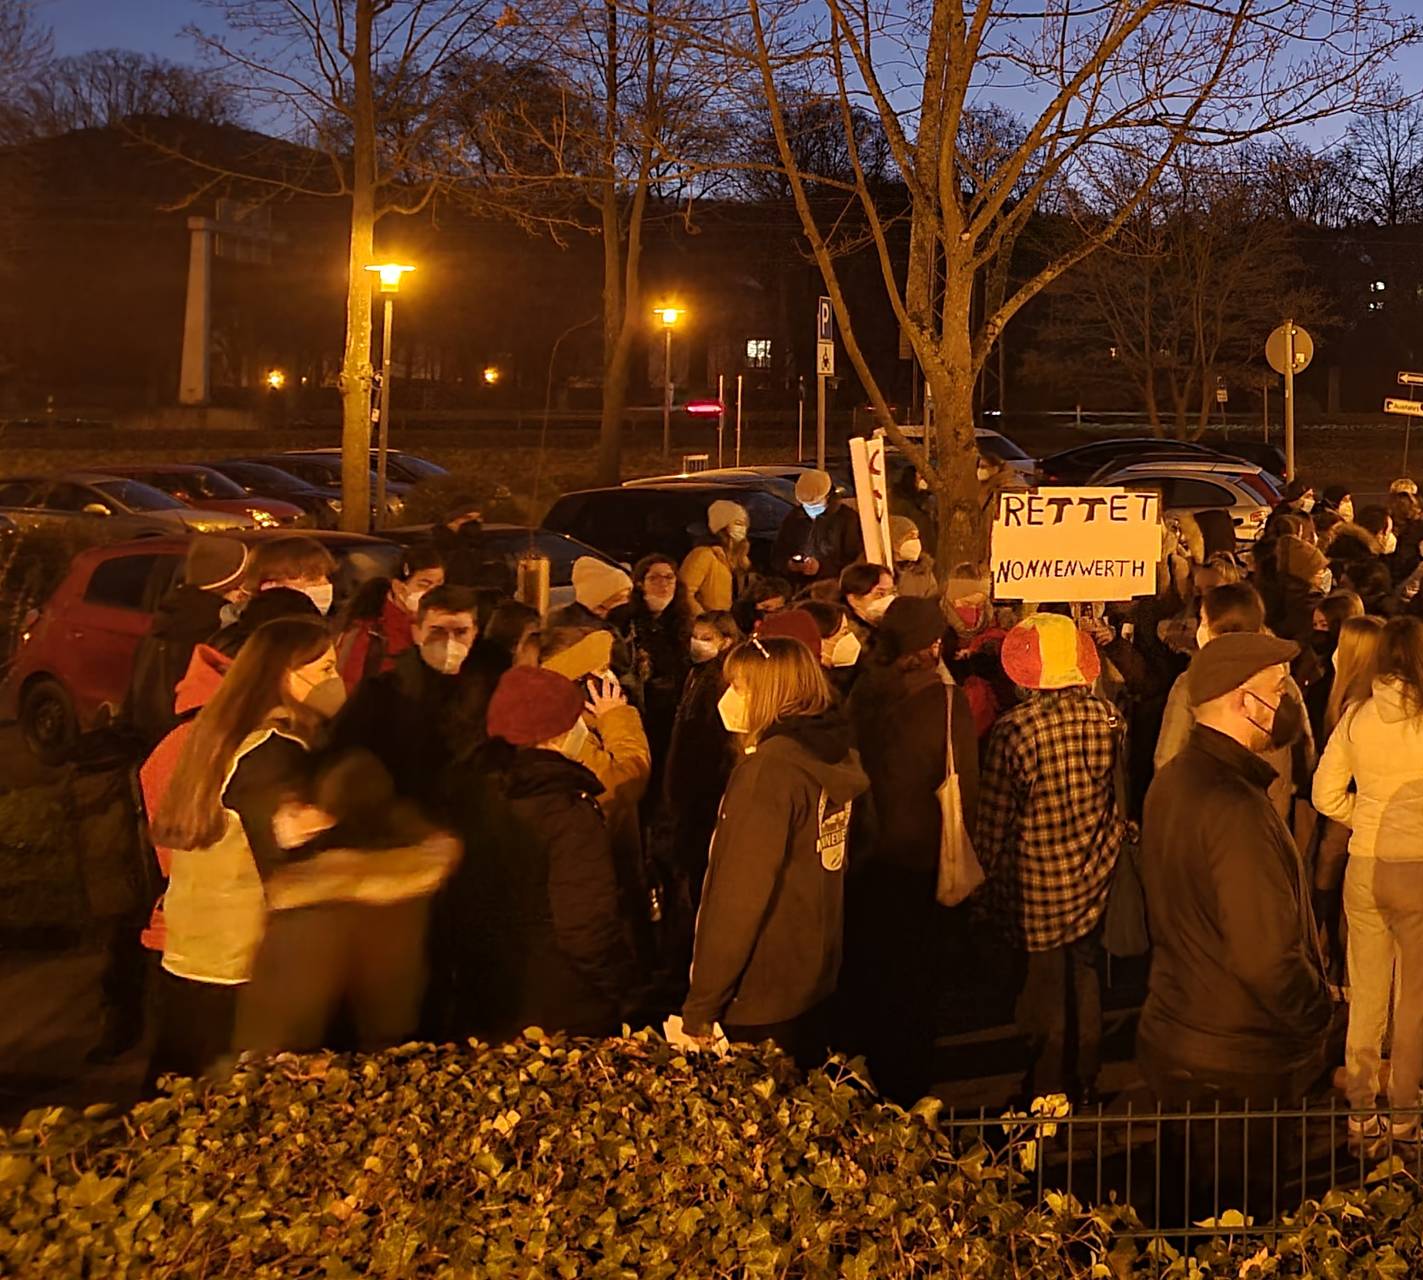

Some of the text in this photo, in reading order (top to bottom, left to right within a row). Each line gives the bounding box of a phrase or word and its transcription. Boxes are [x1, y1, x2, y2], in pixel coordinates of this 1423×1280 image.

[821, 303, 830, 335] P
[1003, 495, 1158, 527] RETTET
[996, 560, 1145, 583] NONNENWERTH
